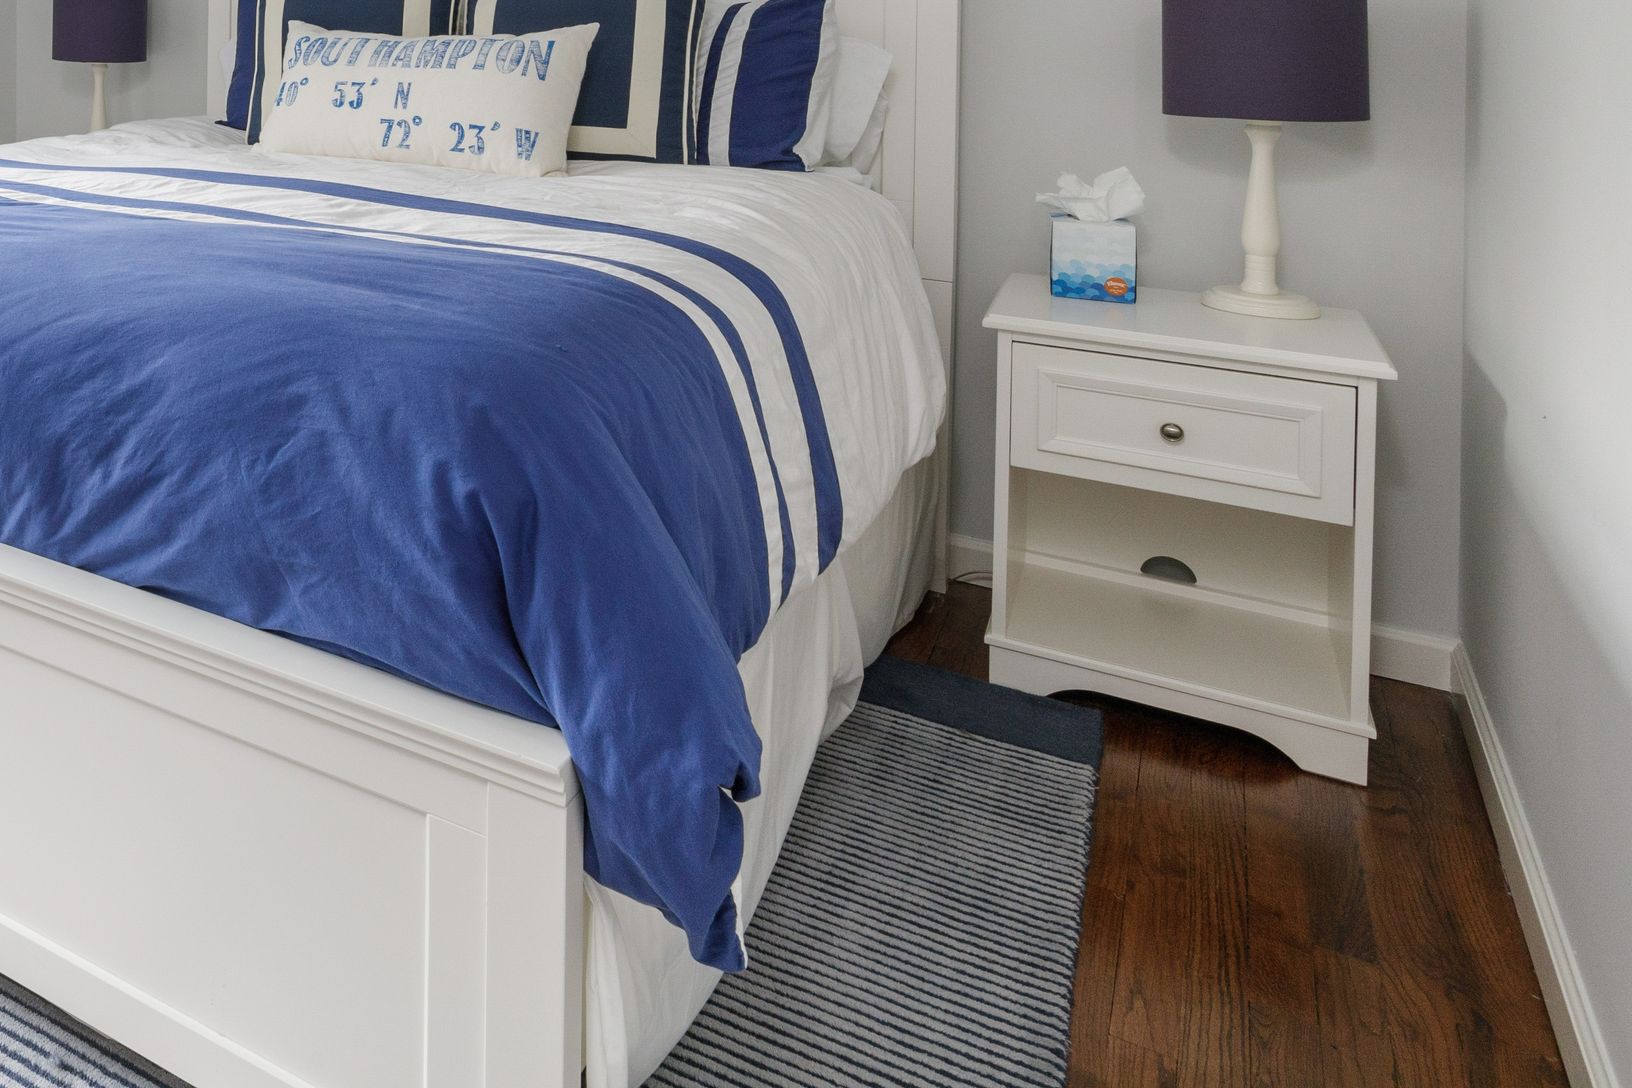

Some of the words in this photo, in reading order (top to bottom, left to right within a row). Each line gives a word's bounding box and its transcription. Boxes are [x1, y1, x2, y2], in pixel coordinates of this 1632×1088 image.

[287, 35, 556, 81] SOUTHAMPTON
[394, 82, 411, 110] N
[515, 127, 540, 161] W
